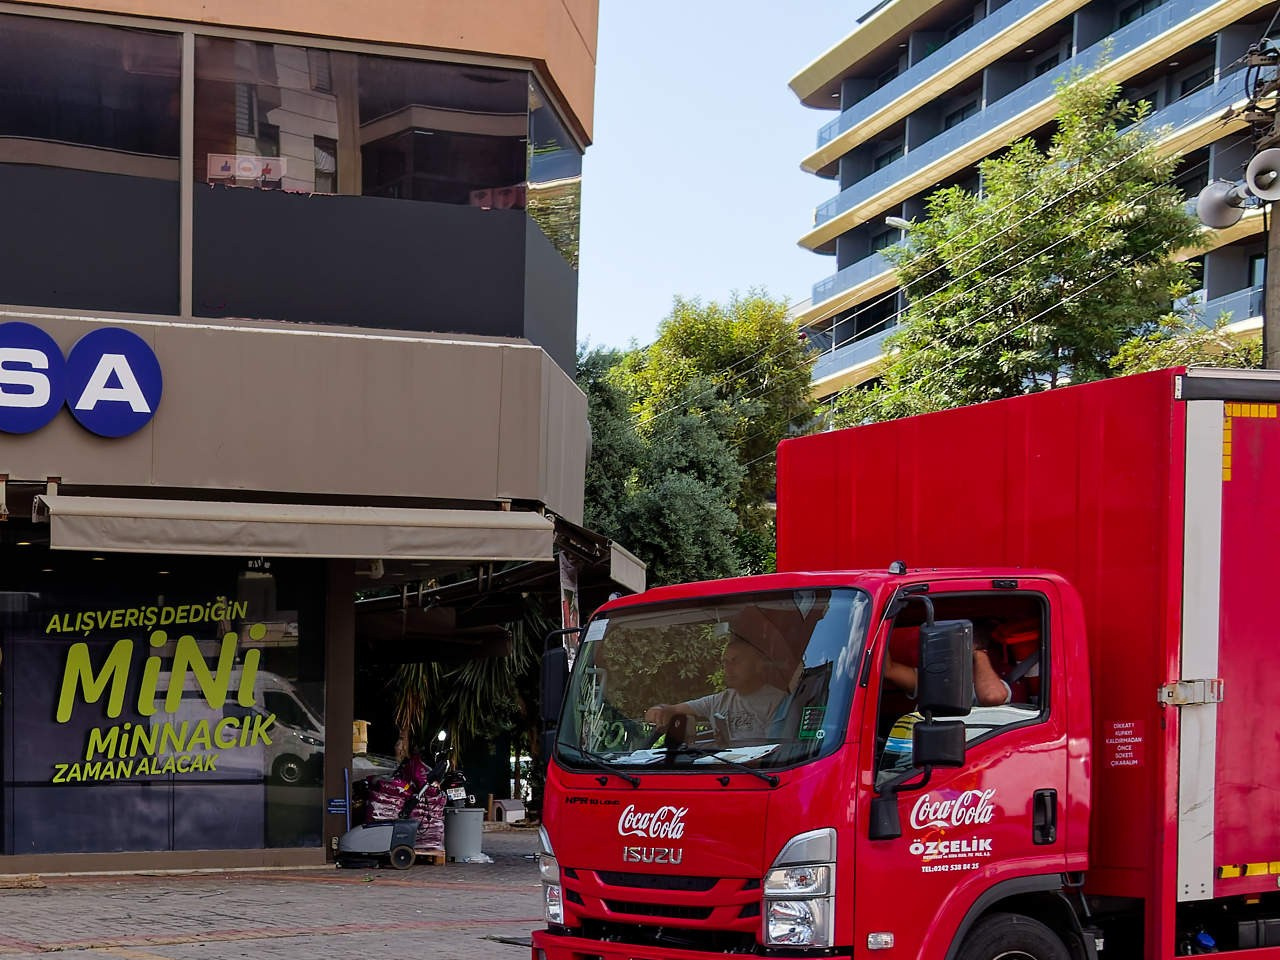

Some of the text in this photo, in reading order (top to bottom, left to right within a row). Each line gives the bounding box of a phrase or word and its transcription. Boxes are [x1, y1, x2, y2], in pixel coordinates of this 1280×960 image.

[52, 753, 220, 784] ZAMAN ALACAK
[623, 846, 683, 865] ISUZU
[909, 835, 993, 857] ÖZÇELİK
